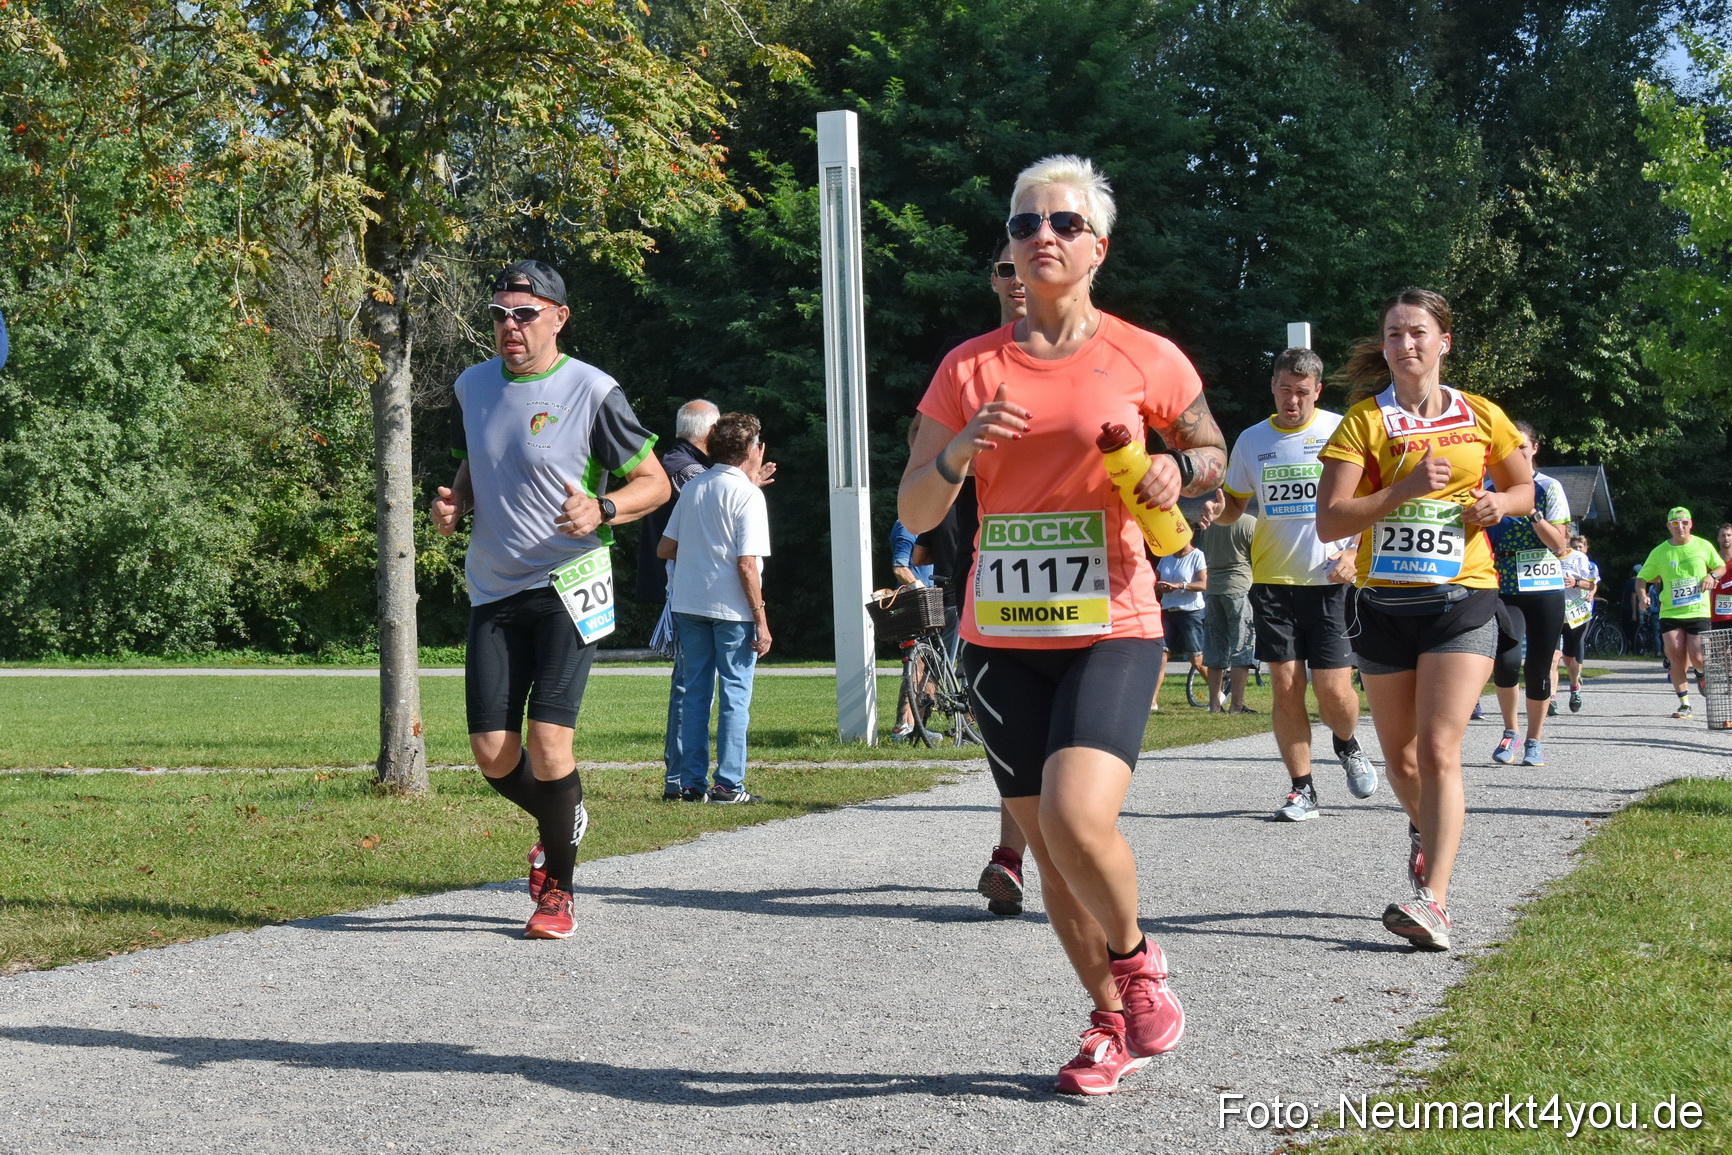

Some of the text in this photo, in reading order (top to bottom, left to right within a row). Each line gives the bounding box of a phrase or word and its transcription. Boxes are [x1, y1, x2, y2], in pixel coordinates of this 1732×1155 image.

[1389, 432, 1481, 457] MAX BÖGL
[1266, 465, 1317, 479] BOCK
[1268, 483, 1316, 501] 2290
[1272, 505, 1315, 513] HERBERT
[987, 518, 1092, 546] BOCK
[1381, 527, 1453, 555] 2385
[1391, 560, 1438, 573] TANJA
[1523, 563, 1556, 577] 2605
[990, 556, 1089, 593] 1117
[1674, 586, 1698, 598] 2237
[1000, 606, 1079, 621] SIMONE
